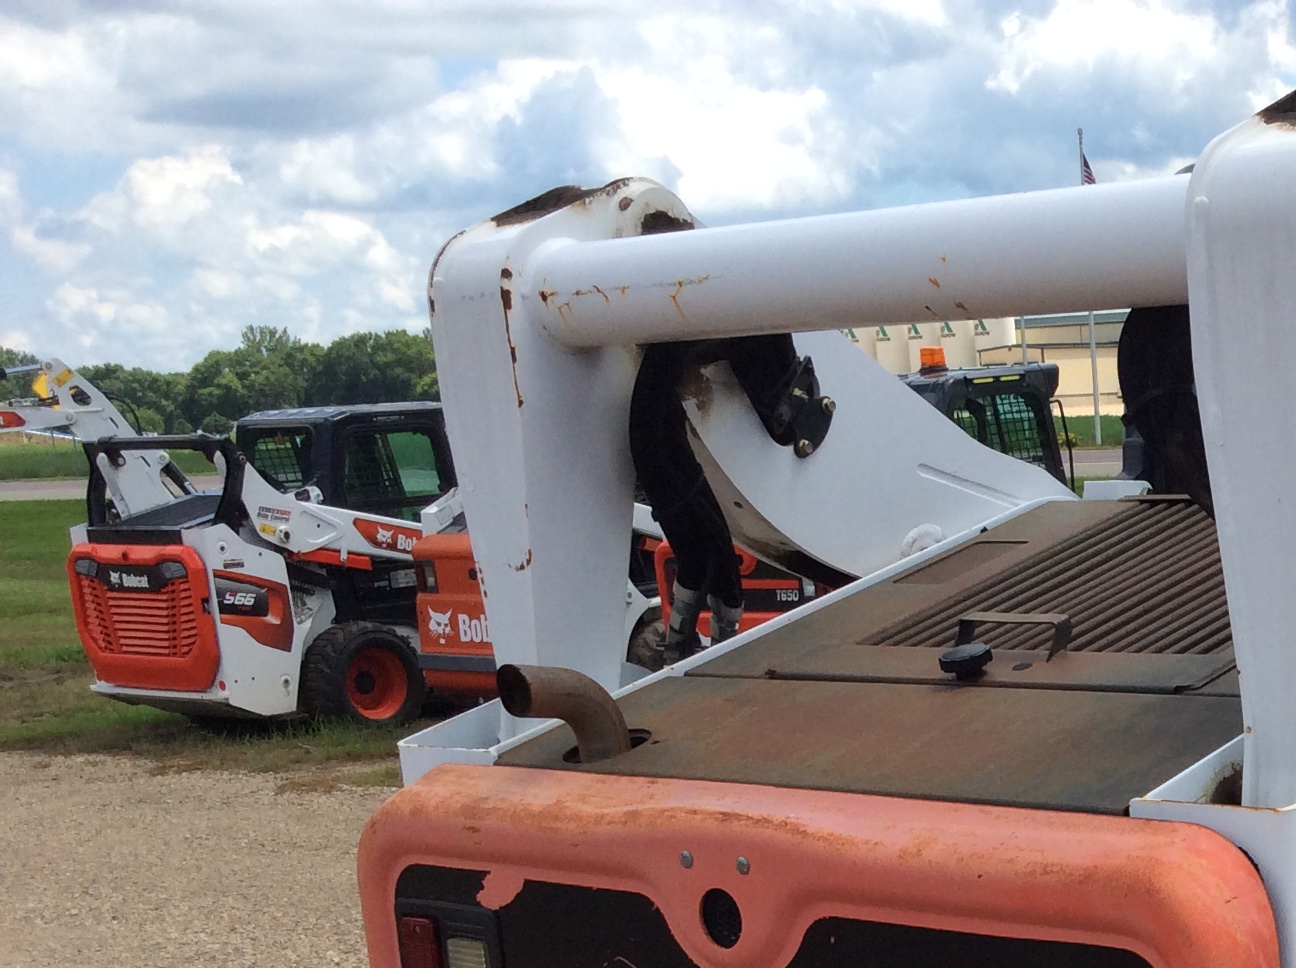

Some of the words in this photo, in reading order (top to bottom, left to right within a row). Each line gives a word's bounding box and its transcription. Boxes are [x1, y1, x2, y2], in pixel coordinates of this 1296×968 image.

[122, 573, 149, 588] Bobcat
[223, 592, 256, 606] S66
[776, 589, 799, 602] T650
